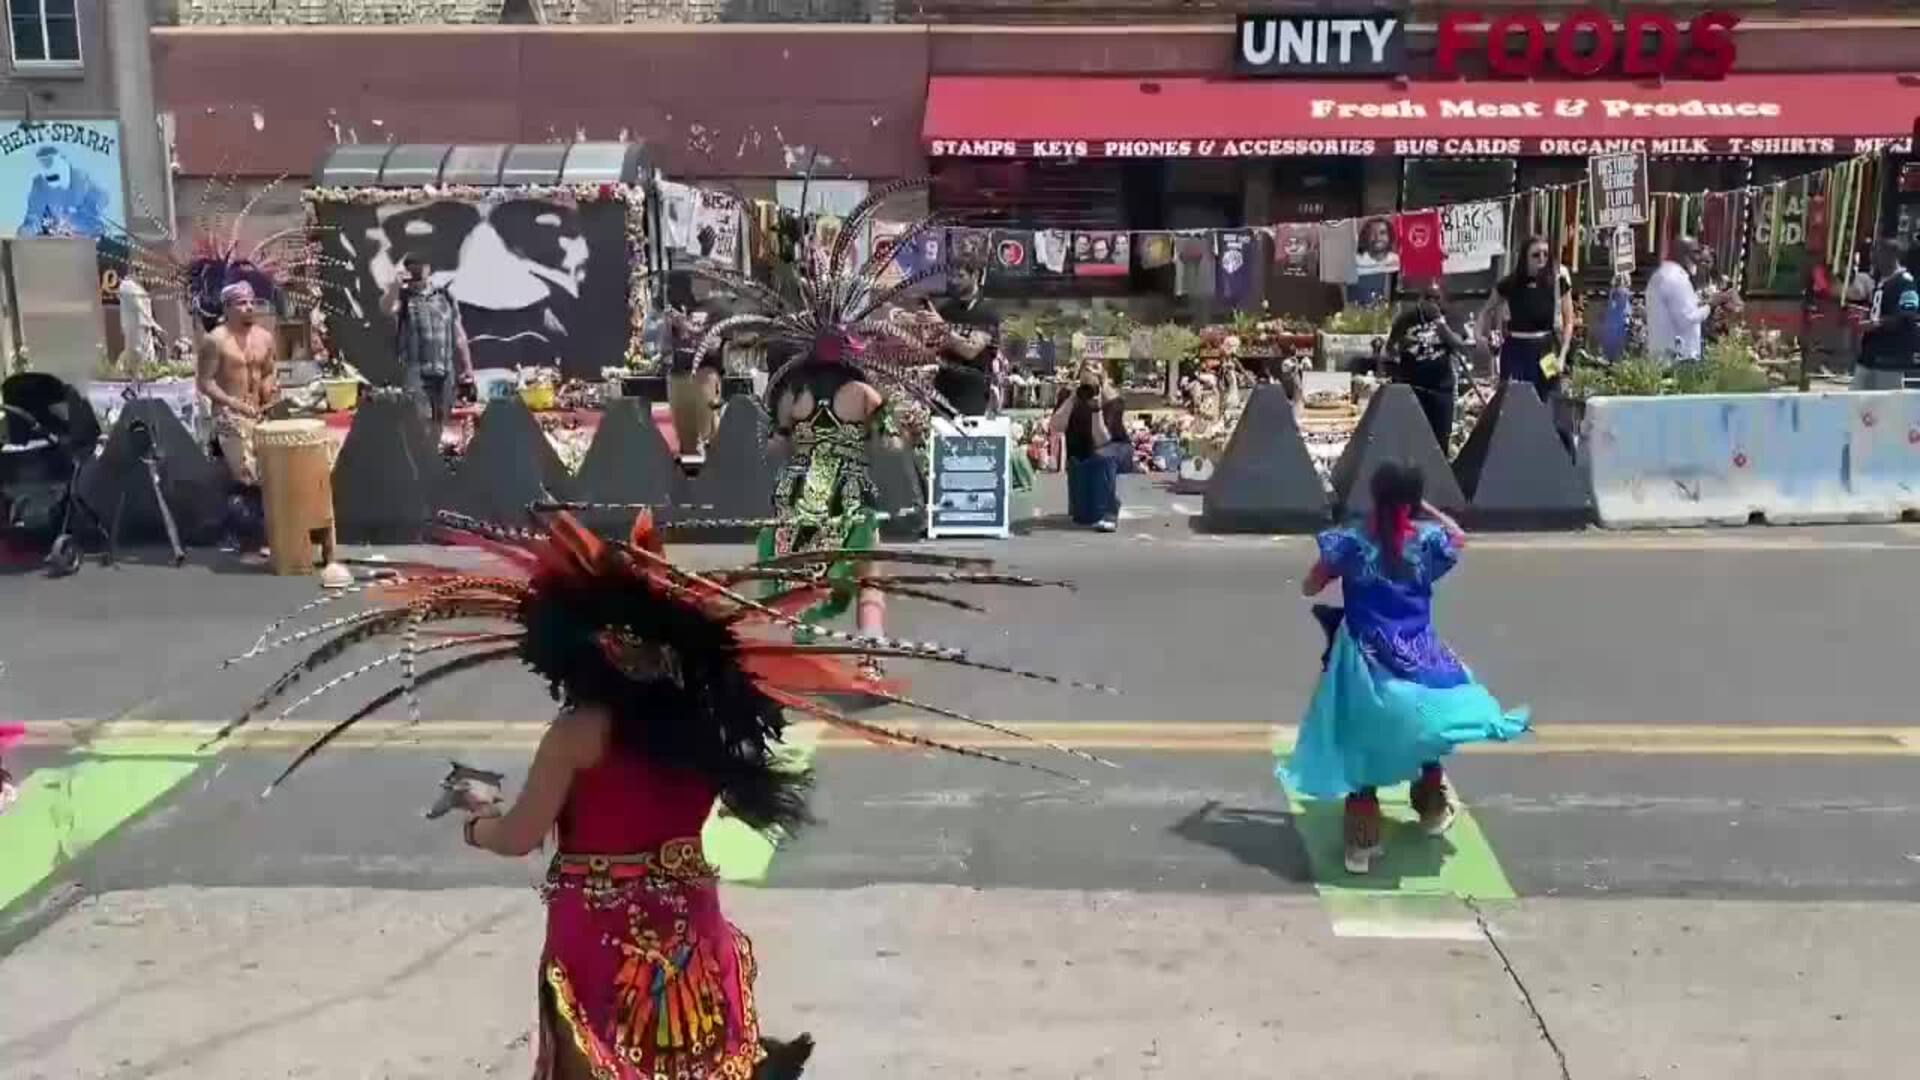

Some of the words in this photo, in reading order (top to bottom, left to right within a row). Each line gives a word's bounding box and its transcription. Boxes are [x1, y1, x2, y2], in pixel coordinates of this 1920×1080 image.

[1243, 19, 1398, 64] UNITY
[1437, 9, 1739, 77] FOODS
[1311, 99, 1428, 118] Fresh
[1440, 99, 1543, 118] Meat
[1554, 99, 1590, 118] &
[1600, 99, 1780, 118] Produce
[932, 140, 1016, 156] STAMPS
[1033, 140, 1088, 157] KEYS
[1104, 140, 1191, 156] PHONES
[1198, 140, 1216, 156] &
[1223, 139, 1375, 156] ACCESSORIES
[1394, 139, 1439, 155] BUS
[1444, 139, 1521, 155] CARDS
[1540, 138, 1645, 155] ORGANIC
[1651, 138, 1709, 154] MILK
[1728, 138, 1835, 154] T-SHIRTS
